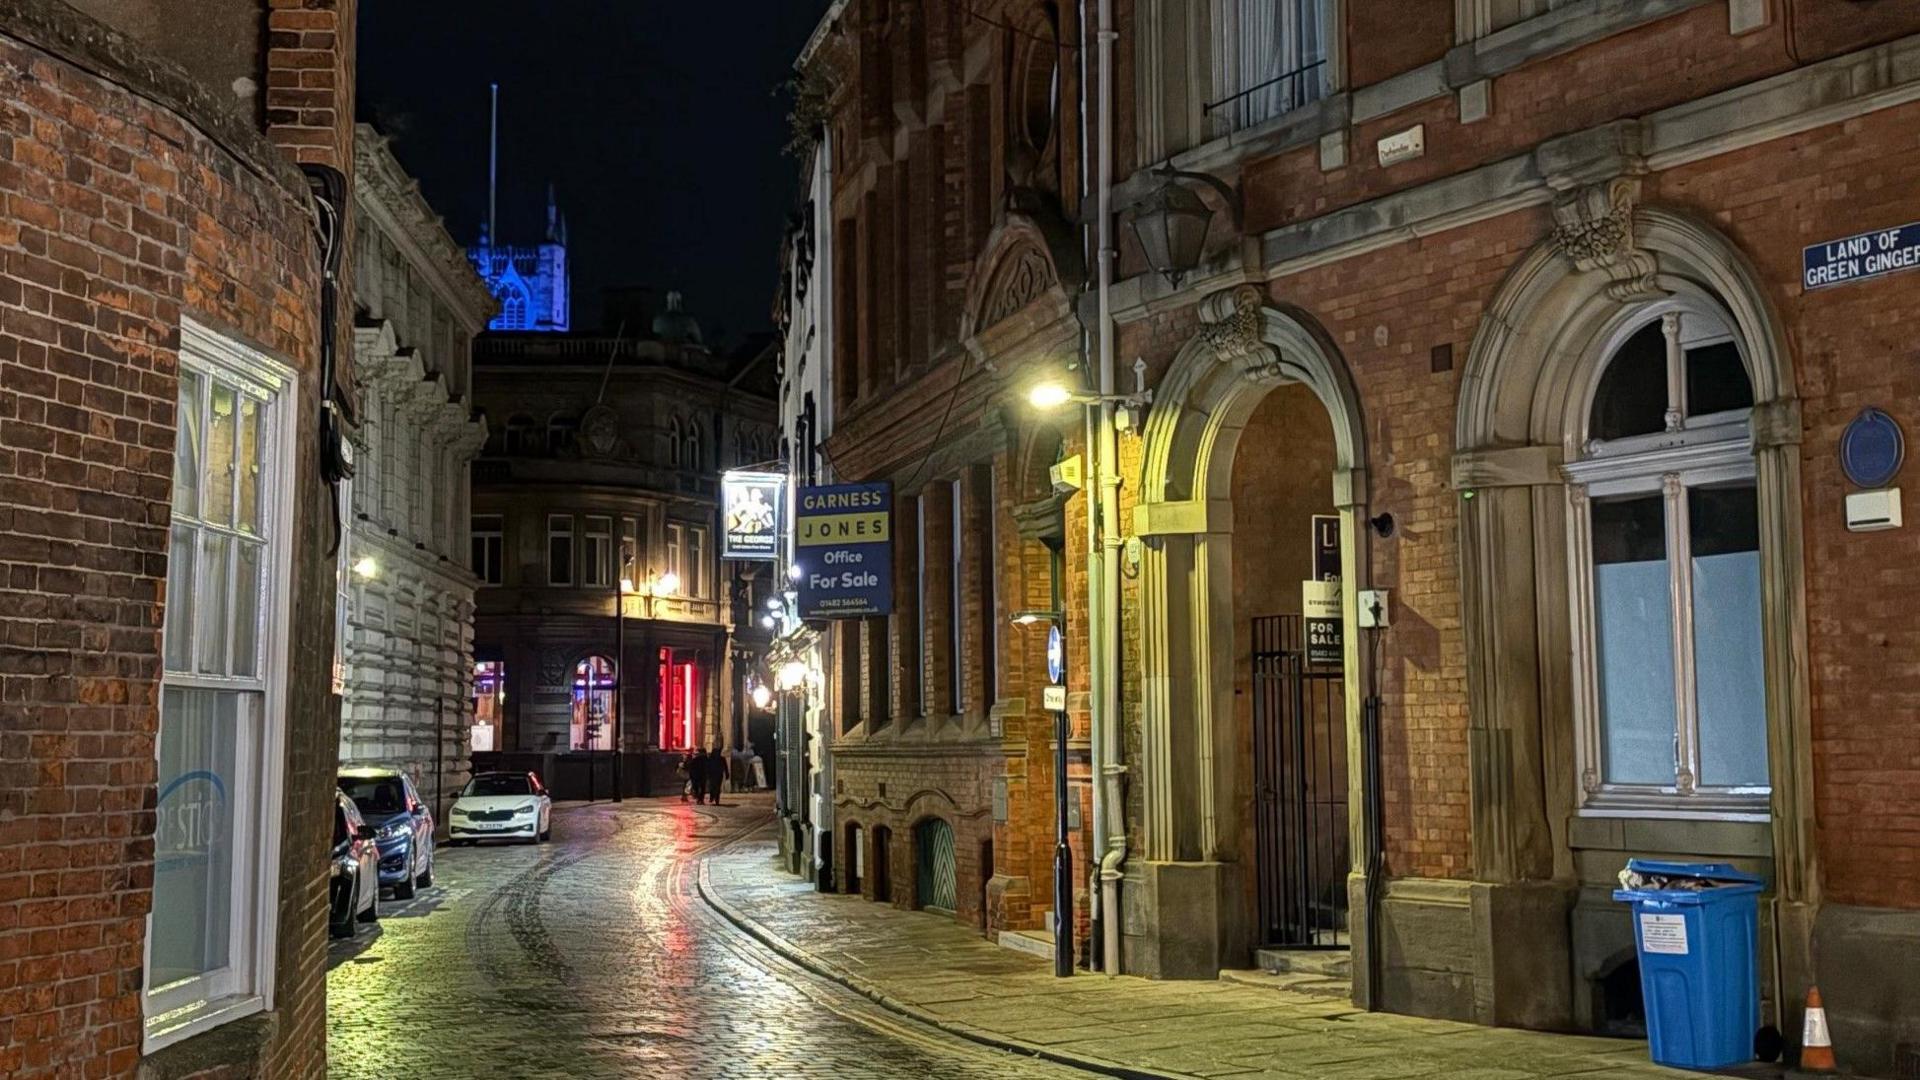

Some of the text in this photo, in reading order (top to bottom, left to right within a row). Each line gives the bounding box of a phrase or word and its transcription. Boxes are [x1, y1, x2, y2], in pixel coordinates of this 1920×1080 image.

[1826, 229, 1901, 262] LAND OF
[1807, 259, 1860, 285] GREEN
[804, 491, 882, 510] GARNESS
[805, 520, 882, 538] JONES
[728, 535, 743, 543] THE
[824, 551, 863, 564] Office
[810, 571, 878, 590] For Sale
[1310, 623, 1334, 633] FOR
[1311, 634, 1341, 645] SALE
